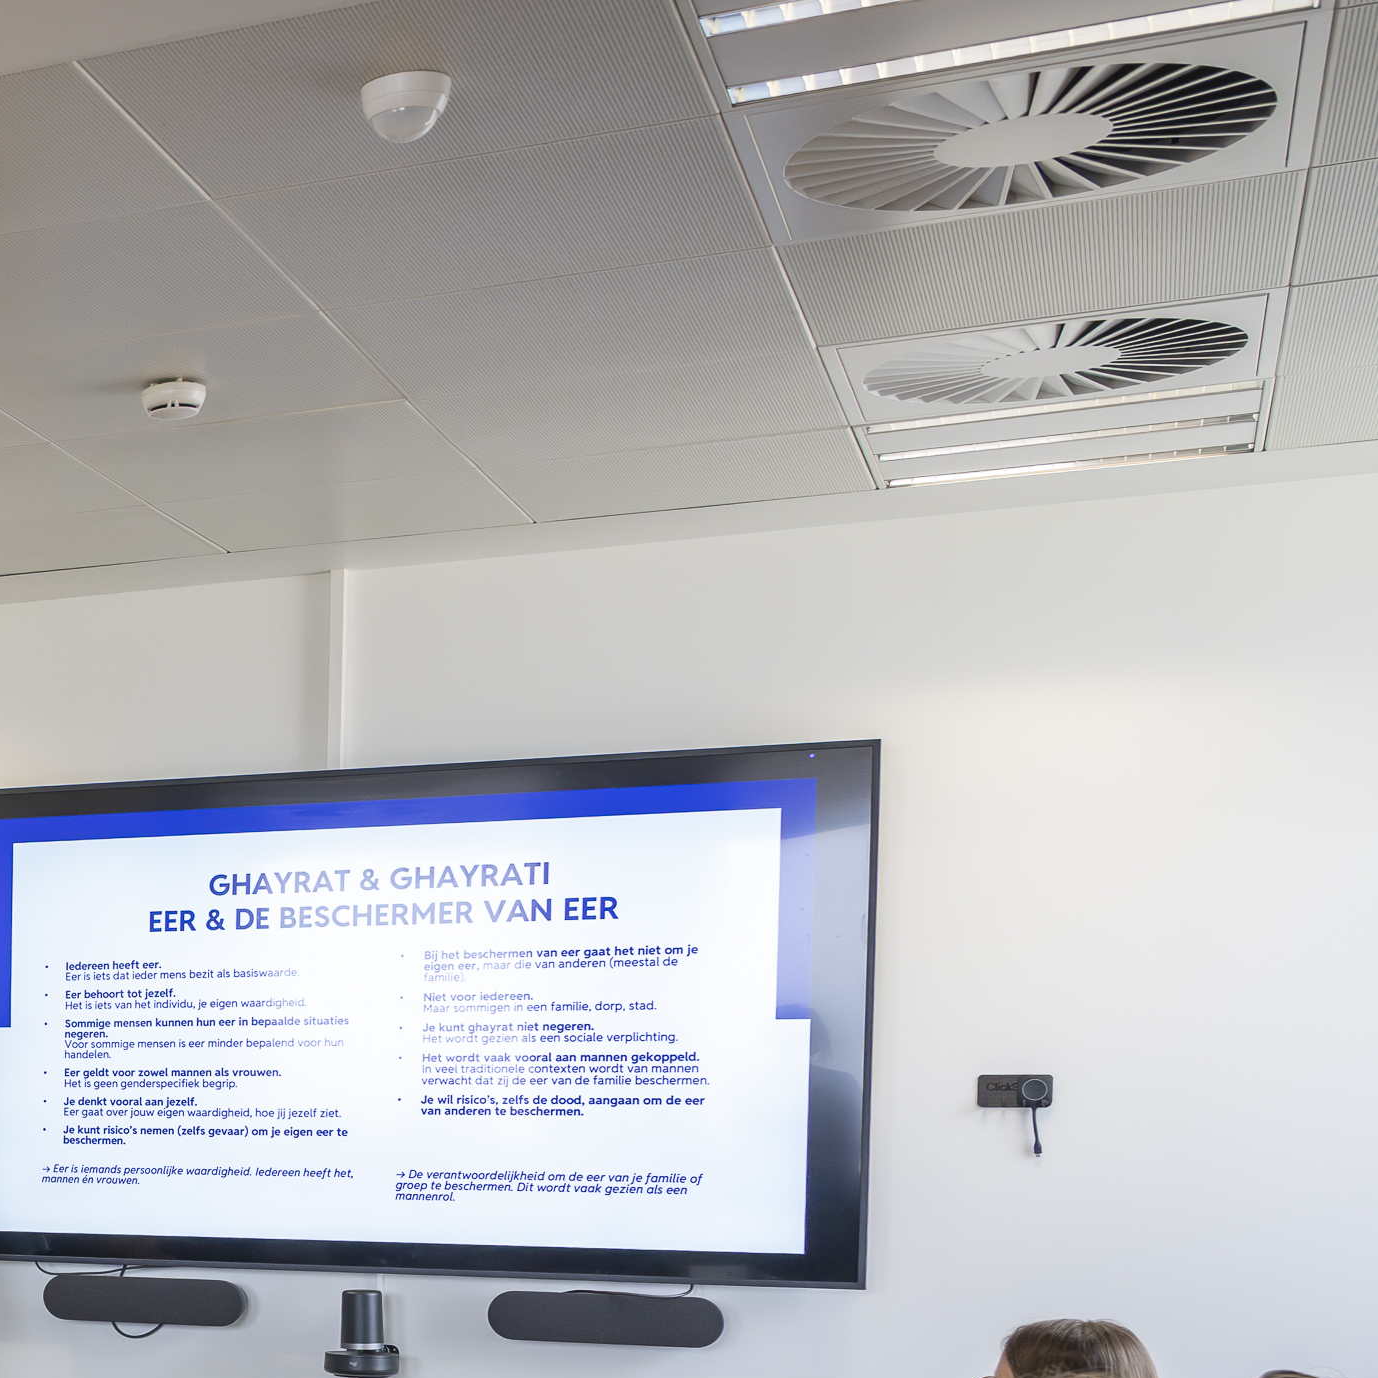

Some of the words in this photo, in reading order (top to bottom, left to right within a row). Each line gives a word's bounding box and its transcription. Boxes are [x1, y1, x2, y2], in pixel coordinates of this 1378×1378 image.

[209, 870, 350, 896] GHAYRAT
[359, 868, 380, 890] &
[389, 862, 549, 890] GHAYRATI
[149, 910, 196, 932] EER
[206, 908, 225, 931] &
[235, 907, 269, 930] DE
[280, 900, 473, 929] BESCHERMER
[484, 898, 551, 923] VAN
[564, 896, 619, 921] EER
[536, 949, 557, 958] van
[560, 949, 580, 957] eer
[583, 947, 610, 959] gaat
[614, 946, 634, 956] het
[637, 946, 661, 956] niet
[664, 947, 683, 955] om
[686, 945, 698, 957] je
[65, 961, 109, 970] Iedereen
[112, 960, 139, 970] heeft
[142, 961, 161, 969] eer.
[534, 961, 555, 969] van
[557, 958, 606, 968] anderen
[608, 957, 659, 970] (meestal
[662, 957, 678, 967] de
[65, 990, 81, 999] Eer
[83, 989, 124, 999] behoort
[126, 989, 142, 998] tot
[144, 989, 176, 1001] jezelf.
[526, 1004, 547, 1012] een
[550, 1002, 591, 1013] familie,
[594, 1002, 625, 1014] dorp,
[628, 1001, 657, 1011] stad.
[64, 1018, 111, 1030] Sommige
[113, 1019, 152, 1027] mensen
[155, 1017, 193, 1027] kunnen
[196, 1017, 215, 1026] hun
[238, 1017, 248, 1026] in
[251, 1016, 300, 1029] bepaalde
[303, 1016, 349, 1026] situaties
[516, 1022, 539, 1031] niet
[542, 1023, 594, 1034] negeren.
[64, 1030, 108, 1041] negeren.
[539, 1035, 560, 1043] een
[563, 1033, 603, 1042] sociale
[606, 1033, 678, 1045] verplichting.
[421, 1053, 442, 1062] Het
[445, 1053, 480, 1062] wordt
[483, 1053, 510, 1062] vaak
[514, 1053, 552, 1062] vooral
[555, 1054, 576, 1062] aan
[579, 1054, 627, 1062] mannen
[630, 1053, 699, 1065] gekoppeld.
[64, 1068, 80, 1077] Eer
[82, 1068, 109, 1079] geldt
[111, 1069, 135, 1077] voor
[137, 1068, 168, 1077] zowel
[170, 1069, 212, 1077] mannen
[214, 1068, 229, 1077] als
[231, 1069, 281, 1077] vrouwen.
[528, 1064, 585, 1073] contexten
[588, 1064, 623, 1073] wordt
[574, 1076, 589, 1085] de
[592, 1076, 631, 1085] familie
[634, 1076, 709, 1086] beschermen.
[63, 1096, 75, 1105] Je
[77, 1096, 107, 1106] denkt
[109, 1096, 142, 1106] vooral
[144, 1098, 163, 1106] aan
[166, 1097, 197, 1109] jezelf.
[420, 1095, 433, 1104] Je
[437, 1095, 453, 1104] wil
[456, 1095, 498, 1106] risico’s,
[501, 1095, 529, 1105] zelfs
[532, 1095, 547, 1105] de
[550, 1095, 585, 1106] dood,
[588, 1097, 639, 1108] aangaan
[642, 1097, 662, 1105] om
[665, 1096, 681, 1105] de
[63, 1107, 79, 1116] Eer
[81, 1107, 103, 1119] gaat
[105, 1109, 128, 1117] over
[130, 1107, 154, 1119] jouw
[156, 1108, 184, 1120] eigen
[186, 1108, 252, 1120] waardigheid,
[254, 1108, 274, 1118] hoe
[277, 1108, 285, 1120] jij
[288, 1109, 316, 1121] jezelf
[319, 1109, 341, 1118] ziet.
[444, 1106, 491, 1116] anderen
[494, 1107, 506, 1116] te
[509, 1107, 584, 1116] beschermen.
[62, 1125, 75, 1134] Je
[77, 1125, 100, 1134] kunt
[102, 1125, 137, 1135] risico’s
[139, 1127, 174, 1135] nemen
[176, 1125, 205, 1138] (zelfs
[207, 1126, 248, 1138] gevaar)
[251, 1128, 268, 1136] om
[271, 1127, 281, 1139] je
[283, 1127, 313, 1139] eigen
[336, 1127, 348, 1137] te
[62, 1135, 126, 1145] beschermen.
[53, 1164, 69, 1173] Eer
[70, 1164, 79, 1174] is
[80, 1164, 122, 1174] iemands
[123, 1165, 184, 1178] persoonlijke
[255, 1167, 301, 1177] Iedereen
[303, 1168, 331, 1178] heeft
[408, 1170, 424, 1179] De
[425, 1170, 546, 1184] verantwoordelijkheid
[547, 1173, 566, 1181] om
[567, 1172, 584, 1182] de
[585, 1174, 606, 1182] eer
[607, 1174, 630, 1182] van
[631, 1173, 644, 1185] je
[645, 1173, 688, 1183] familie
[689, 1174, 703, 1183] of
[40, 1176, 81, 1184] mannen
[395, 1182, 428, 1193] groep
[430, 1181, 442, 1191] te
[516, 1183, 534, 1192] Dit
[536, 1183, 571, 1193] wordt
[573, 1184, 602, 1193] vaak
[604, 1184, 644, 1197] gezien
[646, 1185, 664, 1194] als
[666, 1187, 688, 1195] een
